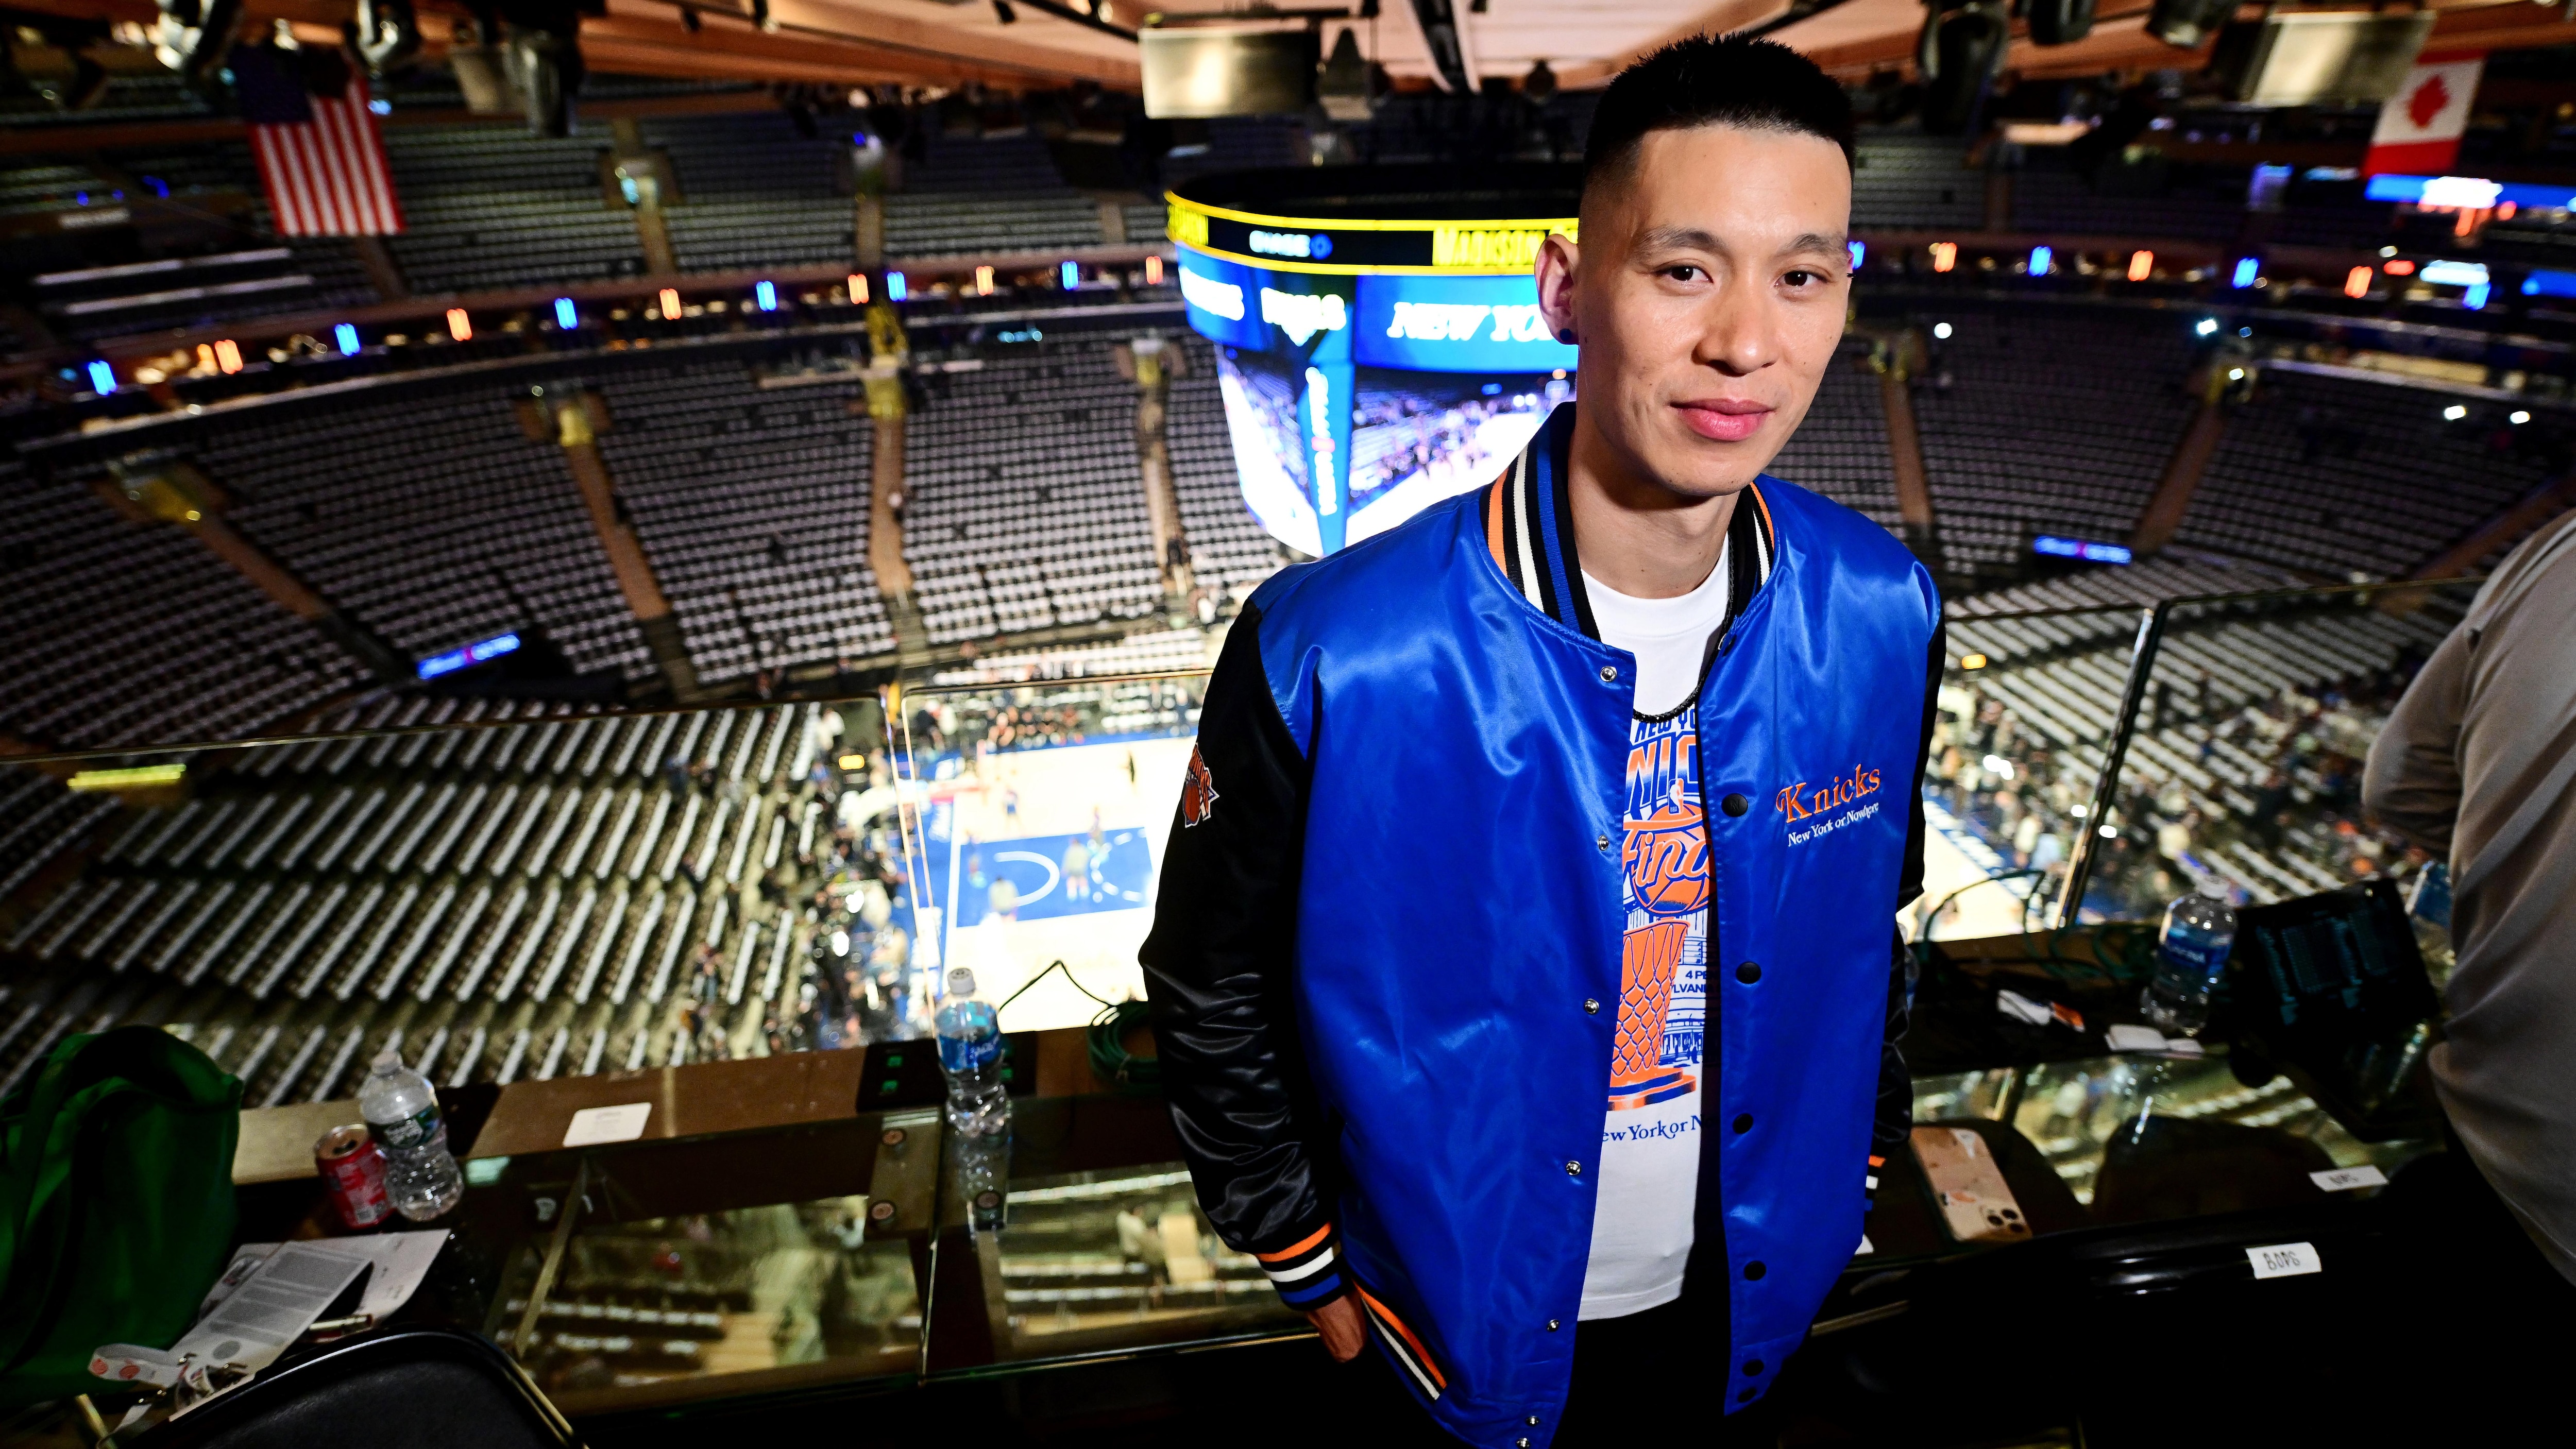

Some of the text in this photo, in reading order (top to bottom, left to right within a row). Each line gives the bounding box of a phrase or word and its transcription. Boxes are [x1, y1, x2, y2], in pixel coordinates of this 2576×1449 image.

[1386, 302, 1492, 341] NEW
[1634, 719, 1672, 743] NEW
[1776, 763, 1880, 823] Knicks
[1788, 802, 1879, 847] New York or Nowhere
[1685, 970, 1692, 979] 4
[1628, 1120, 1675, 1139] York
[1670, 1121, 1688, 1133] or
